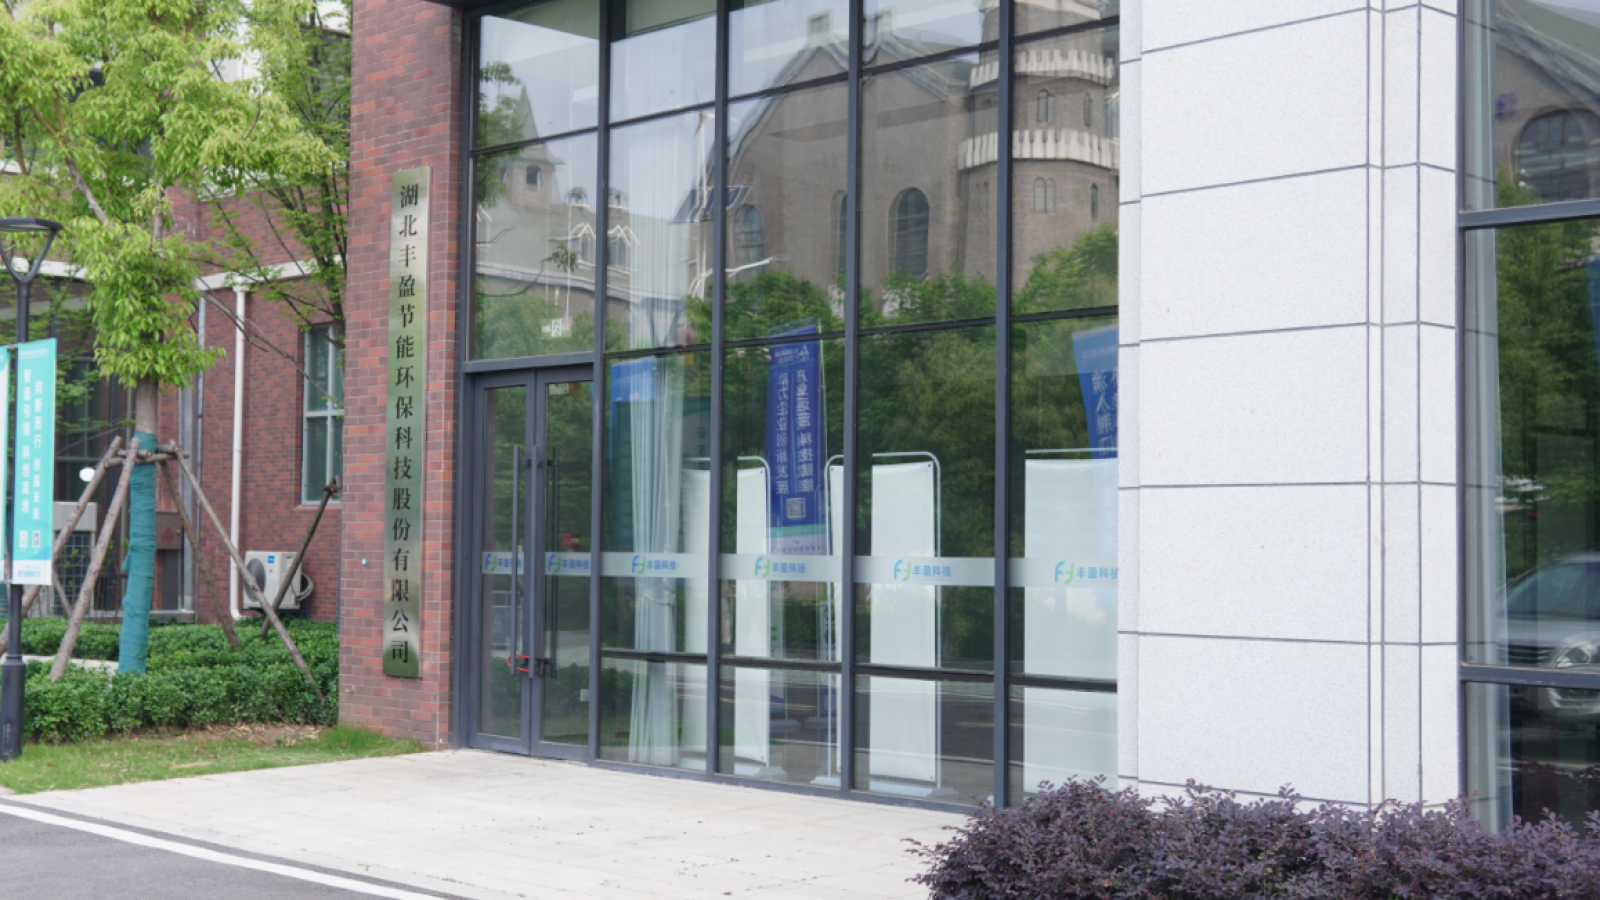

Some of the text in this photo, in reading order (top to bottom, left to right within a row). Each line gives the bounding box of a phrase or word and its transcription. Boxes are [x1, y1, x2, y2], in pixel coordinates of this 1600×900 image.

[391, 183, 419, 664] 湖北丰盈节能环保科技股份有限公司
[646, 559, 677, 571] 丰盈科技
[772, 562, 806, 574] 丰盈科技
[912, 565, 952, 577] 丰盈科技
